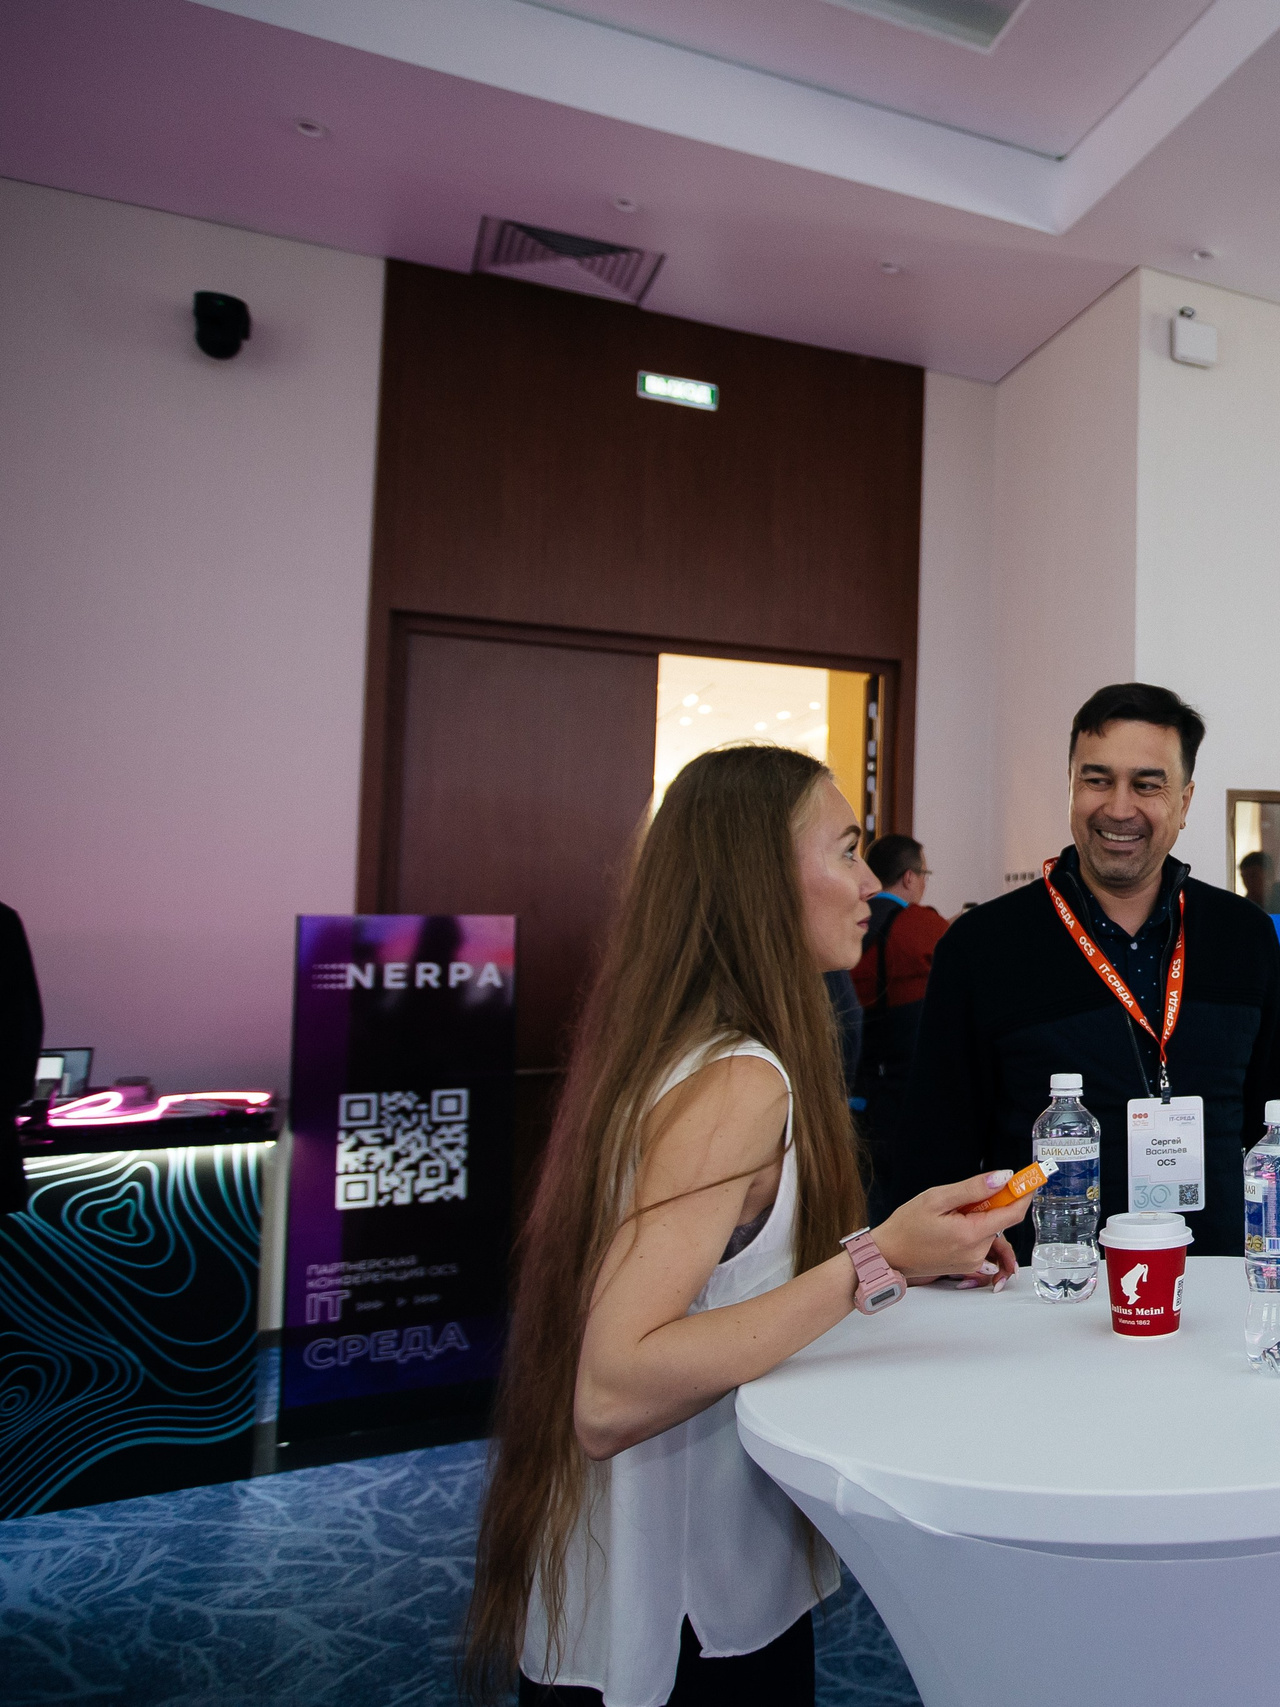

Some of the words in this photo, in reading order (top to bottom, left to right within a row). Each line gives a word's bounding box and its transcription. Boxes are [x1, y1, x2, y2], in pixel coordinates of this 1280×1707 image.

[1049, 886, 1075, 930] IT-СРЕДА
[1079, 935, 1096, 958] OCS
[346, 961, 504, 990] NERPA
[1171, 957, 1181, 979] OCS
[1098, 963, 1135, 1008] IT-СРЕДА
[1163, 990, 1179, 1040] IT-СРЕДА
[1041, 1144, 1097, 1156] БАЙКАЛЬСКАЯ
[1145, 1147, 1187, 1156] Васильев
[1151, 1137, 1182, 1147] Сергей
[1157, 1158, 1176, 1167] OCS
[305, 1289, 352, 1325] IT
[1135, 1306, 1164, 1316] Meinl
[303, 1321, 471, 1370] СРЕДА
